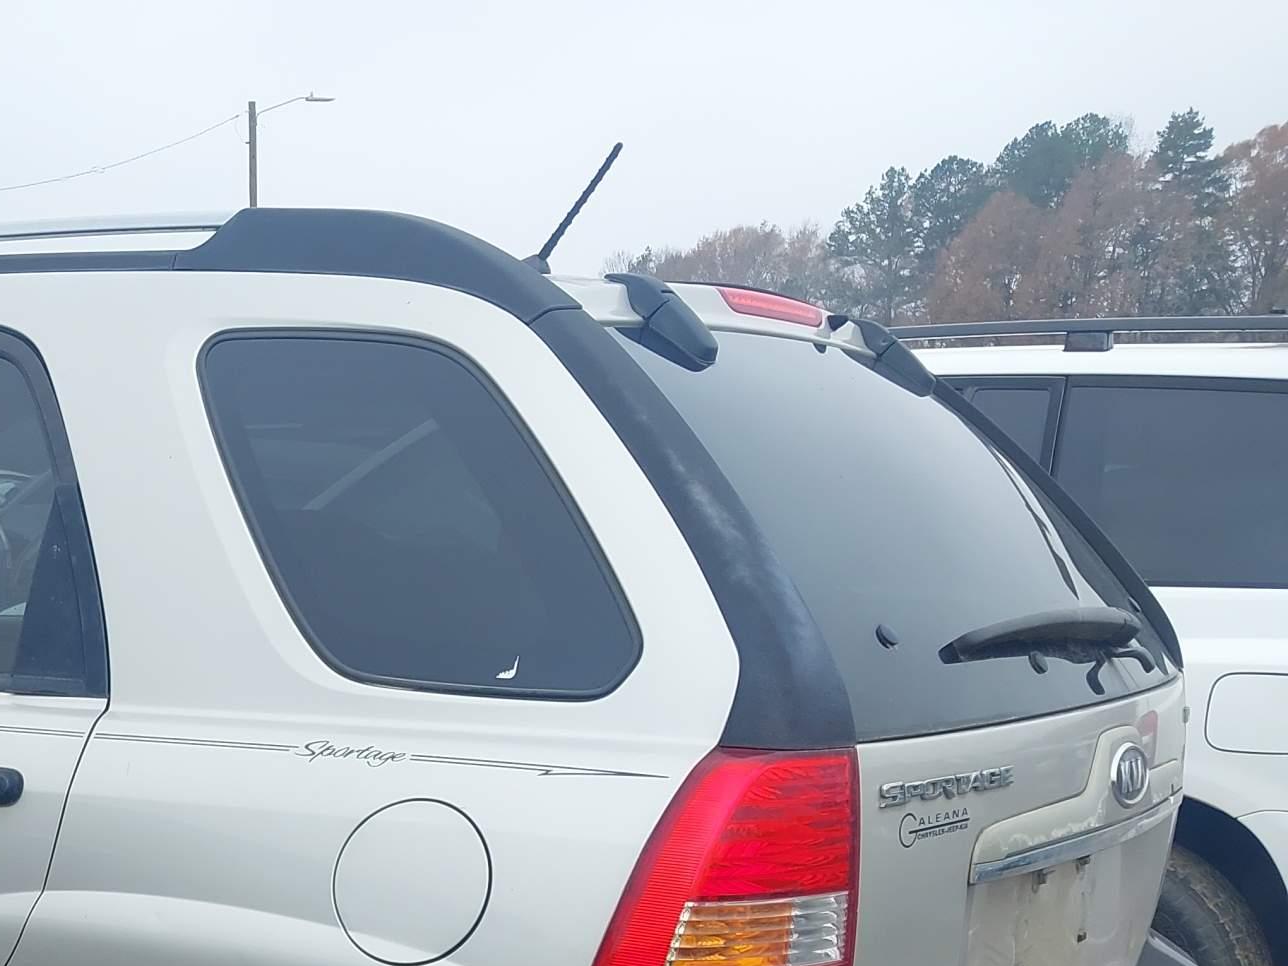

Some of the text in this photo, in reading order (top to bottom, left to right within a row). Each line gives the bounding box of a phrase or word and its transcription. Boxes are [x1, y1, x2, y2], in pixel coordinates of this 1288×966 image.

[294, 740, 407, 767] Sportage
[879, 765, 1015, 809] SPORTAGE
[899, 807, 970, 848] GALEANA
